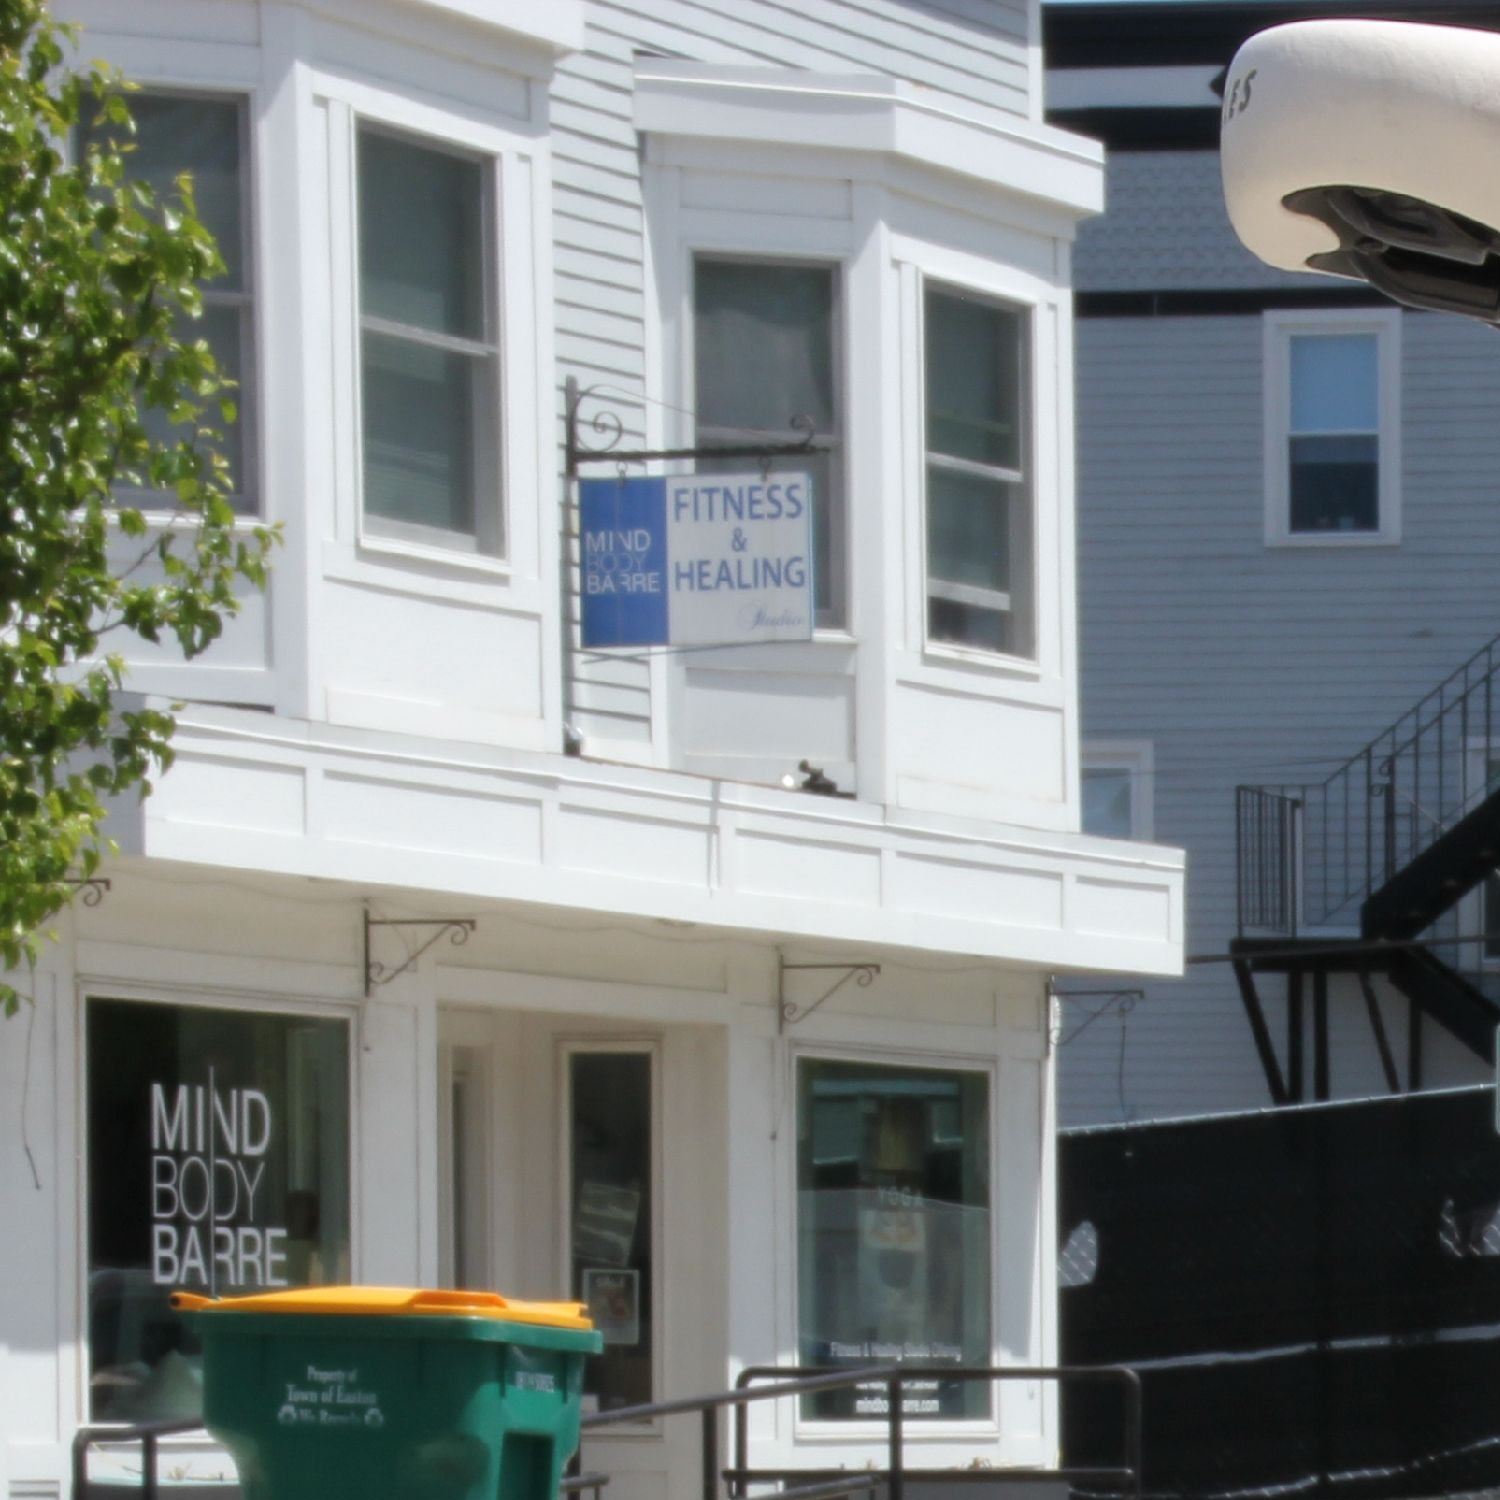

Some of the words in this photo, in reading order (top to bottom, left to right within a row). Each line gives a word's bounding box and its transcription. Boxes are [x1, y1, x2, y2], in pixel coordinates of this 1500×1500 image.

[673, 483, 804, 522] FITNESS
[585, 529, 651, 552] MIND
[731, 527, 748, 552] &
[586, 572, 661, 595] BARRE
[674, 556, 806, 591] HEALING
[151, 1083, 272, 1156] MIND
[151, 1155, 265, 1222] BODY
[152, 1223, 288, 1287] BARRE
